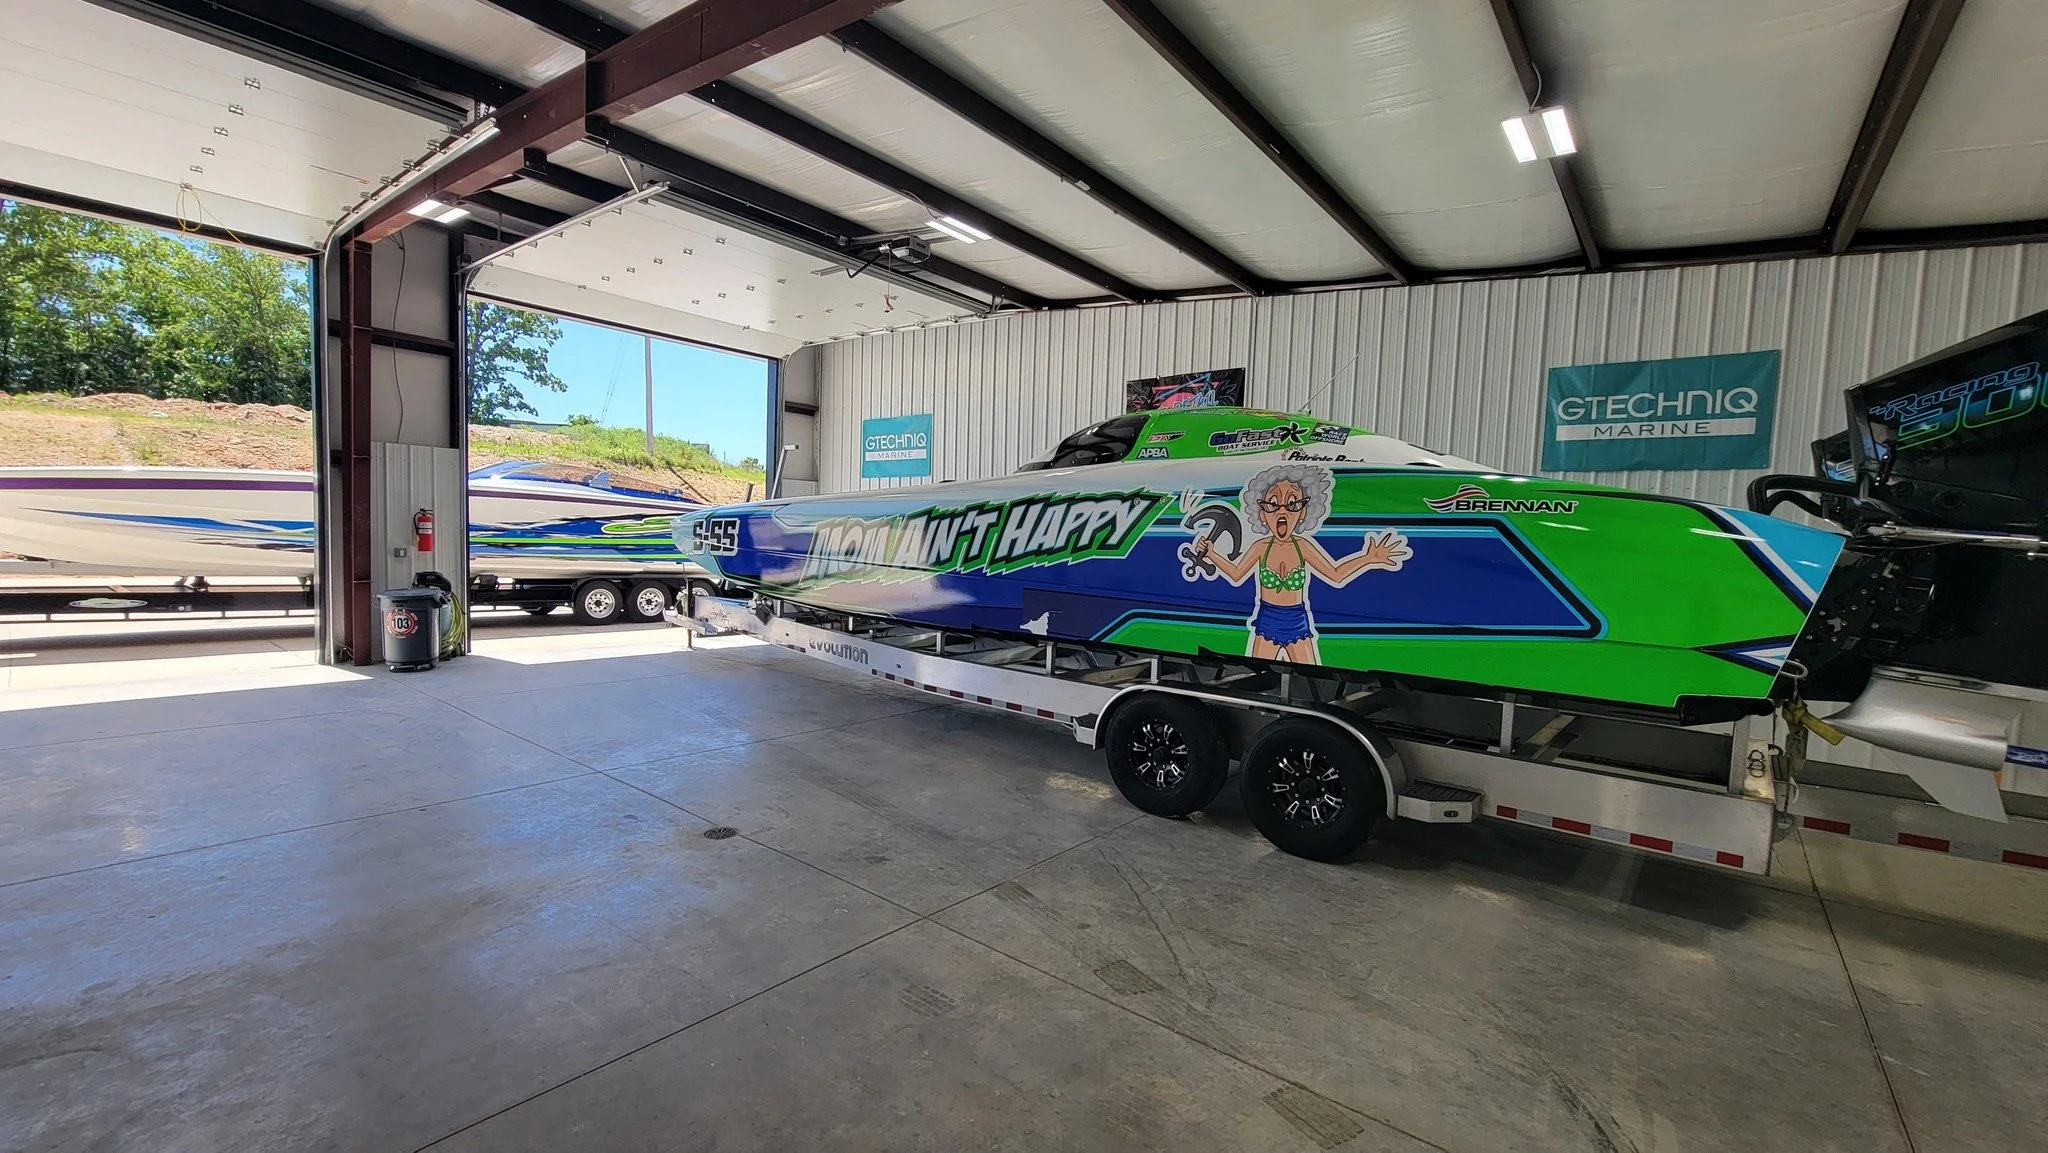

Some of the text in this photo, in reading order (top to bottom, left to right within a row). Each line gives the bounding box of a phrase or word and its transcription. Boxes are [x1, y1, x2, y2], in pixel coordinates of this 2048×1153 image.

[1884, 361, 2039, 420] Racing
[1557, 387, 1758, 421] GTECHNIQ
[1897, 364, 2048, 451] 30
[1210, 427, 1284, 446] GoFast
[1321, 433, 1347, 441] WORLD
[1593, 422, 1712, 437] MARINE
[865, 432, 927, 450] GTECHNIQ
[1217, 443, 1239, 451] BOAT
[1241, 440, 1275, 449] SERVICE
[1309, 435, 1345, 445] OFFSHORE
[877, 451, 913, 459] MARINE
[1137, 448, 1168, 458] APBA
[1455, 500, 1573, 513] BRENNAN
[693, 519, 738, 552] S-55
[994, 499, 1152, 559] HAPPY
[393, 617, 409, 630] 103
